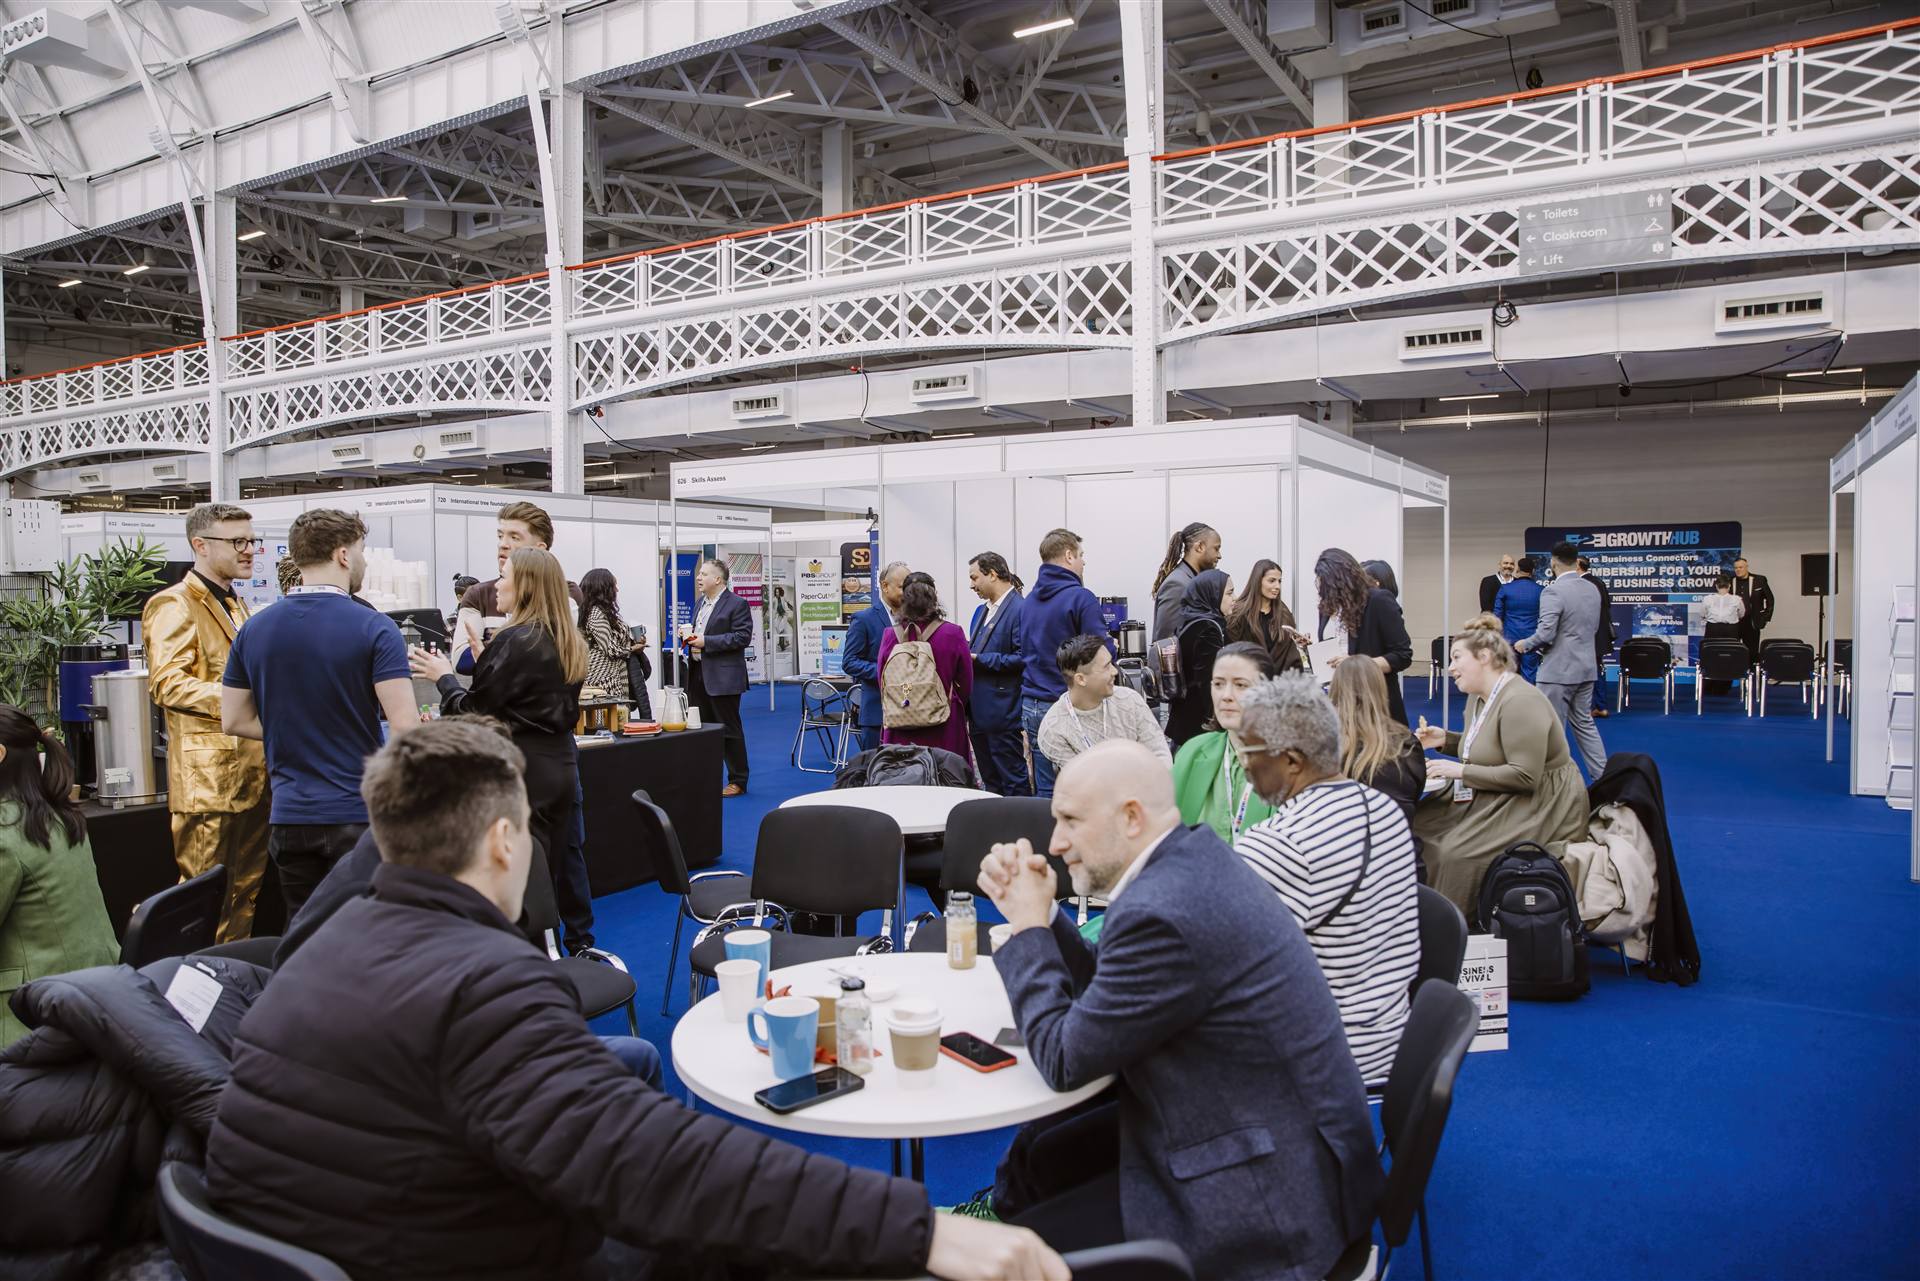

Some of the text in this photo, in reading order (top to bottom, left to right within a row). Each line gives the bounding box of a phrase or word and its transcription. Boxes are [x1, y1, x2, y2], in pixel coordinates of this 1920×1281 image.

[1542, 207, 1579, 221] Toilets
[1542, 228, 1608, 242] Cloakroom
[1543, 255, 1564, 266] Lift
[691, 476, 706, 484] Skills
[1601, 555, 1643, 563] Business
[1646, 554, 1699, 562] Connectors
[1588, 565, 1721, 577] MBERSHIP FOR YOUR
[1613, 578, 1674, 588] BUSINESS
[1677, 578, 1717, 588] GROW
[1461, 965, 1494, 976] SINES
[1459, 974, 1492, 984] EVIVAL
